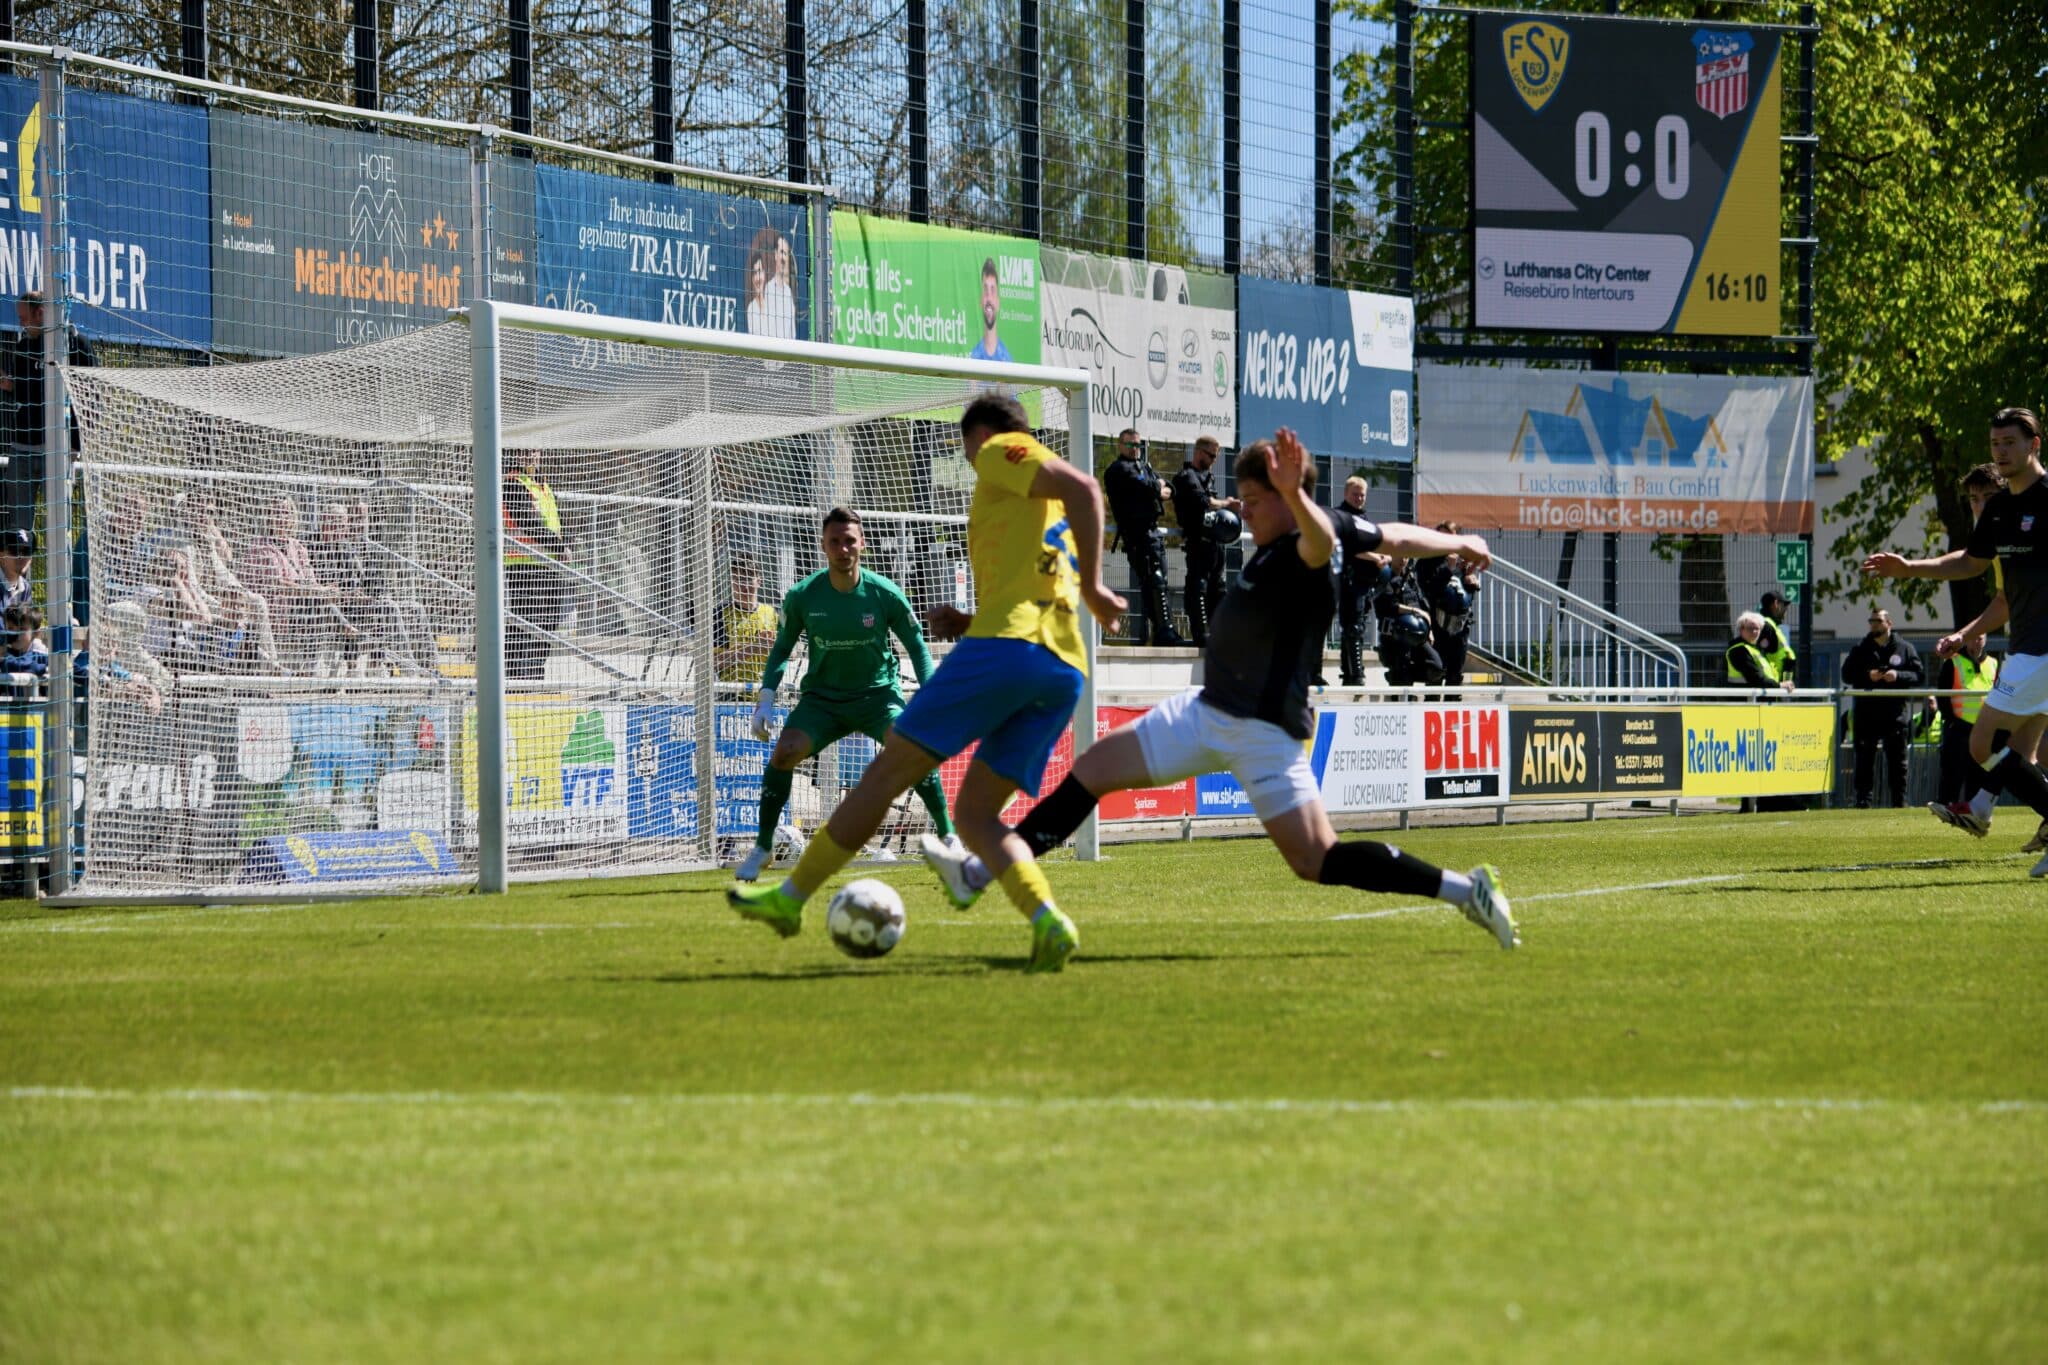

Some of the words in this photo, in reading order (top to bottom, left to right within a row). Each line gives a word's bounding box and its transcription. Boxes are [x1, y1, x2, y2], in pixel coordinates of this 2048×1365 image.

[1701, 53, 1745, 76] FSV
[358, 152, 396, 184] HOTEL
[222, 208, 232, 225] Ihr
[233, 211, 253, 229] Hotel
[608, 197, 632, 224] Ihre
[635, 201, 693, 233] individuell
[231, 235, 275, 255] Luckenwalde
[579, 221, 628, 252] geplante
[630, 233, 717, 282] TRAUM-
[1504, 261, 1571, 280] Lufthansa
[1574, 263, 1602, 283] City
[1605, 265, 1651, 283] Center
[295, 247, 418, 305] Märkischer
[422, 263, 461, 310] Hof
[840, 256, 869, 295] gebt
[875, 260, 902, 294] alles
[1705, 272, 1767, 302] 16:10
[1504, 281, 1569, 300] Reisebüro
[1573, 284, 1635, 302] Intertours
[663, 281, 737, 333] KÜCHE
[846, 300, 888, 343] geben
[893, 303, 967, 345] Sicherheit!
[1148, 406, 1232, 430] www.autoforum-prokop.de
[1519, 473, 1629, 495] Luckenwalder
[1634, 476, 1665, 496] Bau
[1669, 478, 1720, 498] GmbH
[1519, 499, 1719, 529] info@luck-bau.de
[1354, 712, 1407, 737] STÄDTISCHE
[1424, 709, 1499, 771] BELM
[1687, 727, 1777, 774] Reifen-Müller
[1333, 749, 1408, 773] BETRIEBSWERKE
[1521, 729, 1587, 786] ATHOS
[1134, 796, 1157, 809] Sparkasse
[1343, 782, 1408, 806] LUCKENWALDE
